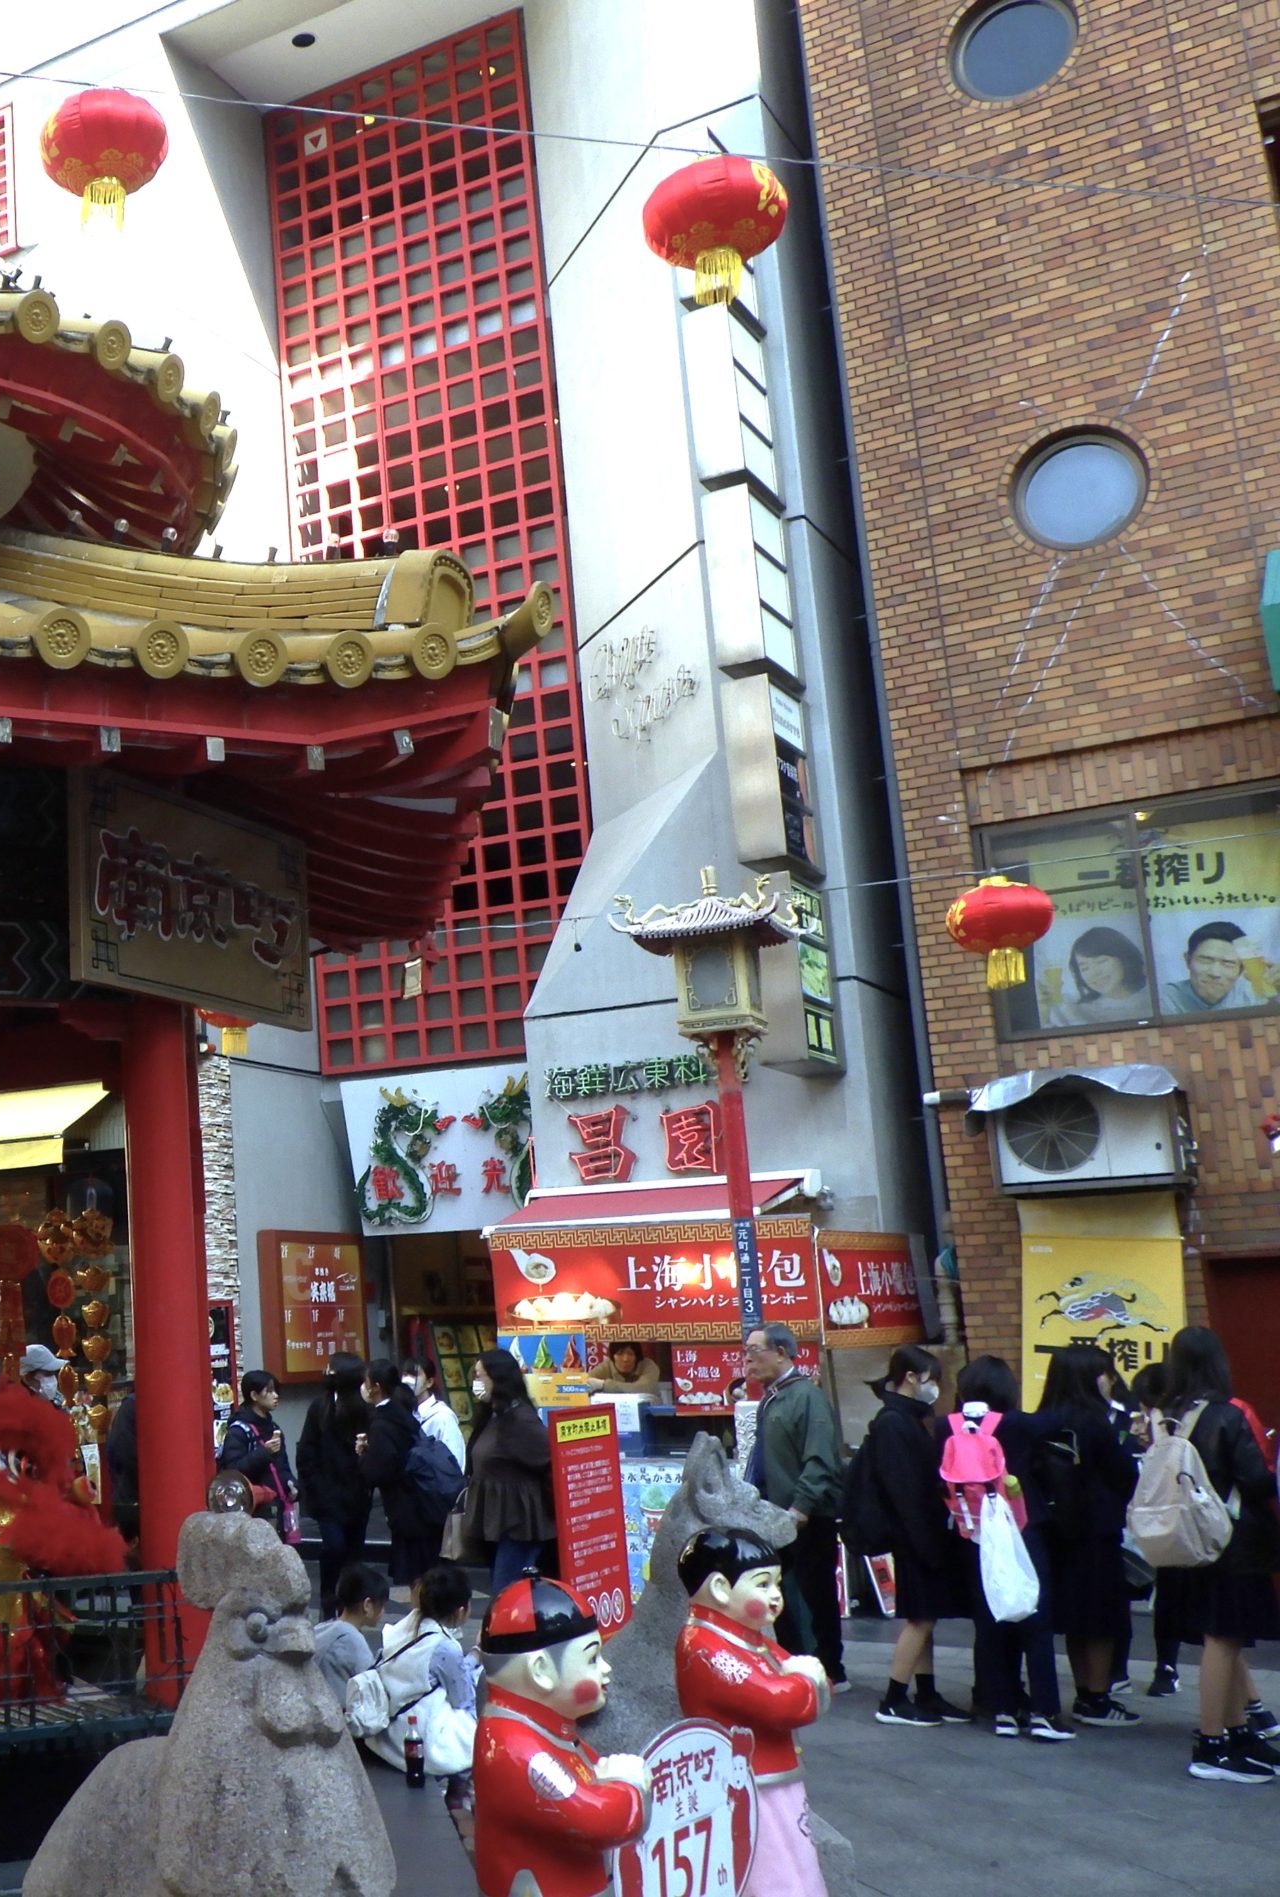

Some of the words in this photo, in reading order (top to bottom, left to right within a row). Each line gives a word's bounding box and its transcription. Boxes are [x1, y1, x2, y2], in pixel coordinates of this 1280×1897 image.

[94, 826, 298, 969] 南京町
[1077, 851, 1226, 889] 一番搾り
[567, 1099, 720, 1185] 昌園
[650, 1746, 716, 1806] 南京町
